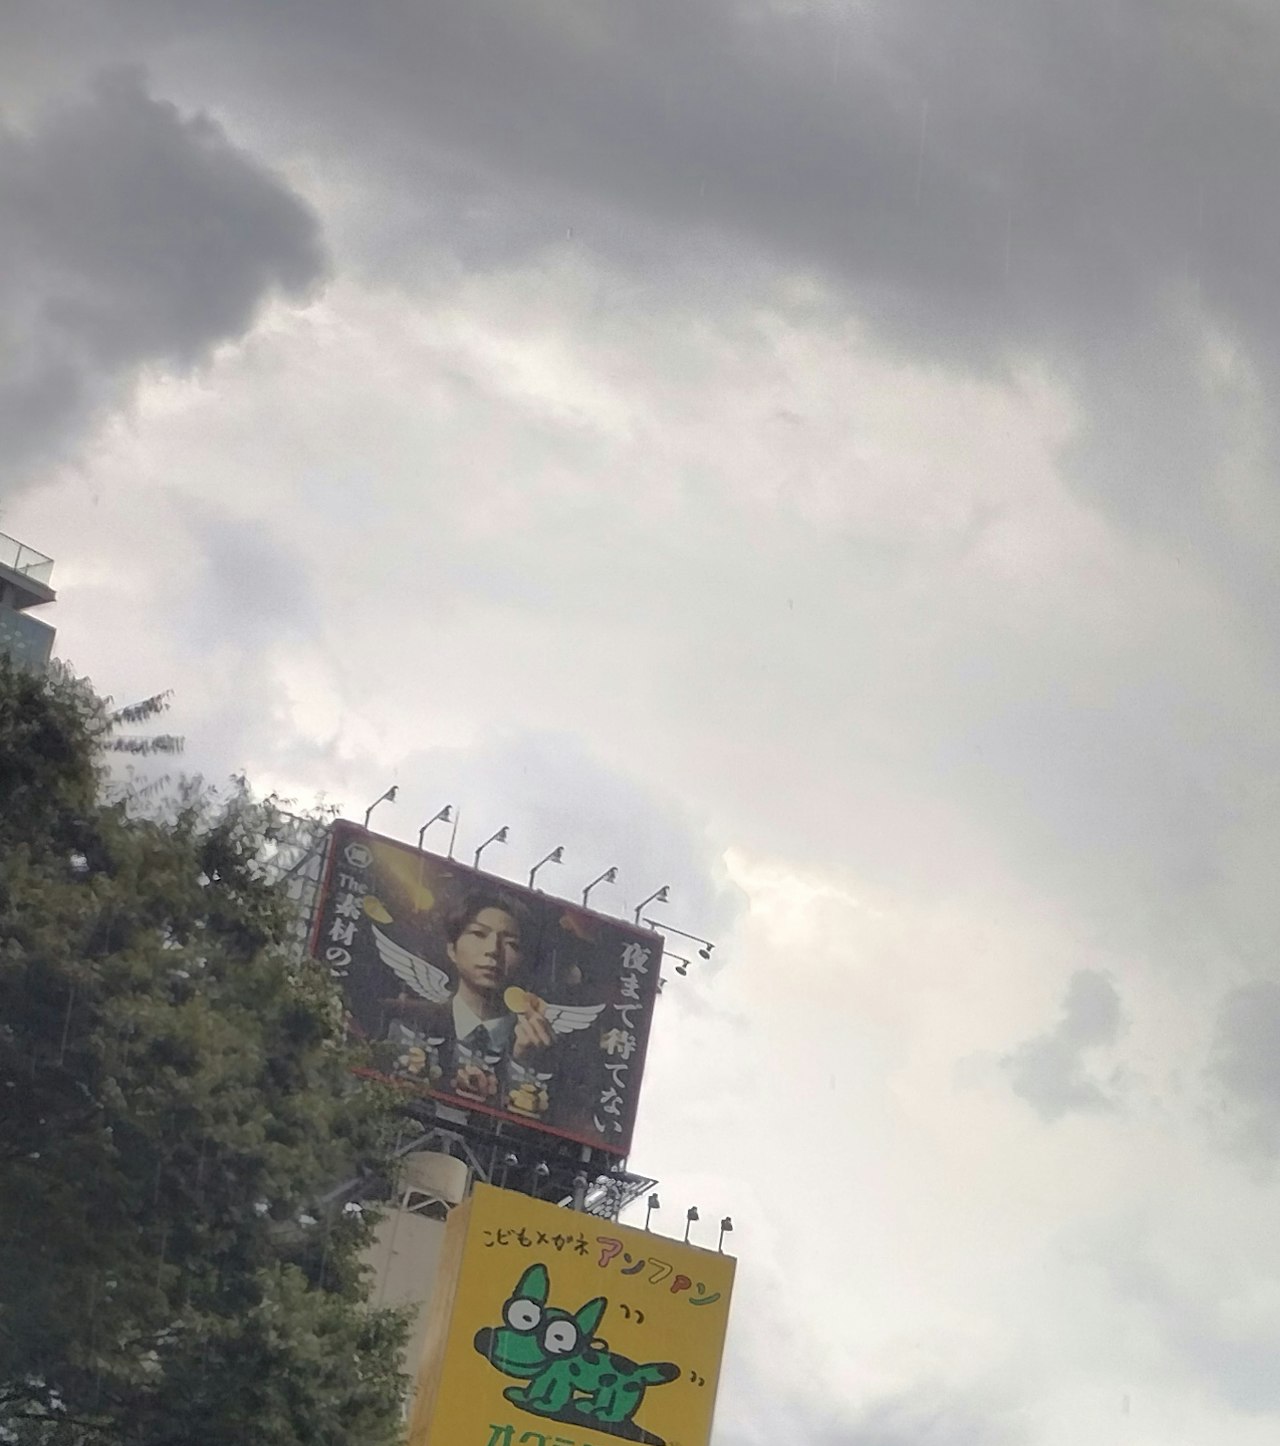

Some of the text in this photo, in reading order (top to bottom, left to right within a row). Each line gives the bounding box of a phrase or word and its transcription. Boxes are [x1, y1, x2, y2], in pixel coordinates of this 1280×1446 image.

[339, 873, 369, 894] The
[326, 894, 364, 976] 素材の
[594, 942, 651, 1133] 夜まで待てない
